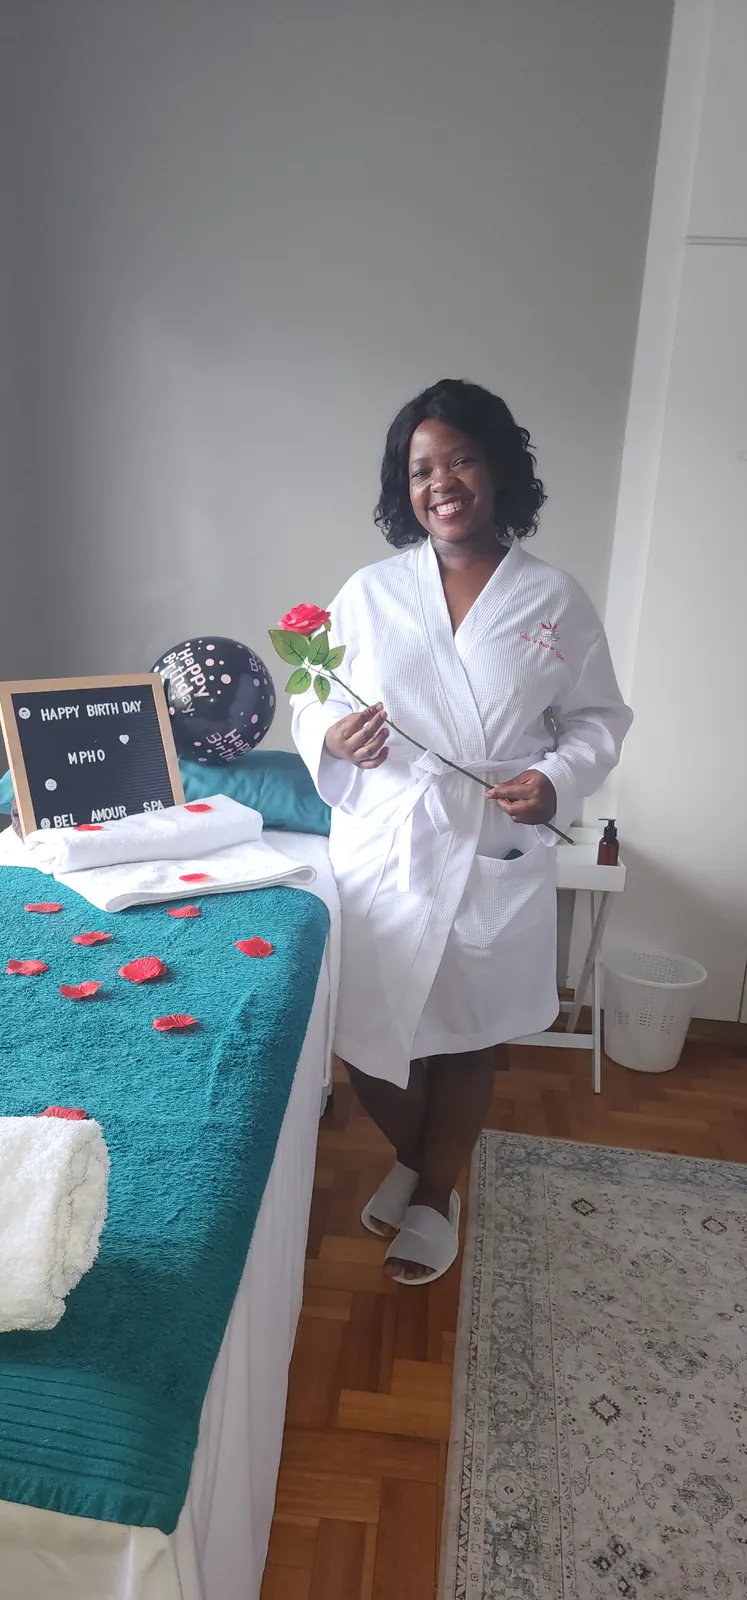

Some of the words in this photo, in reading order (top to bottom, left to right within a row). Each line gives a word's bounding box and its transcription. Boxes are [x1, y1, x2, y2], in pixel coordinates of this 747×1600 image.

[163, 651, 196, 714] Birthday
[178, 648, 210, 698] Happy
[40, 705, 80, 722] HAPPY
[67, 749, 106, 765] MPHO
[91, 805, 127, 823] AMOUR
[143, 799, 165, 814] SPA
